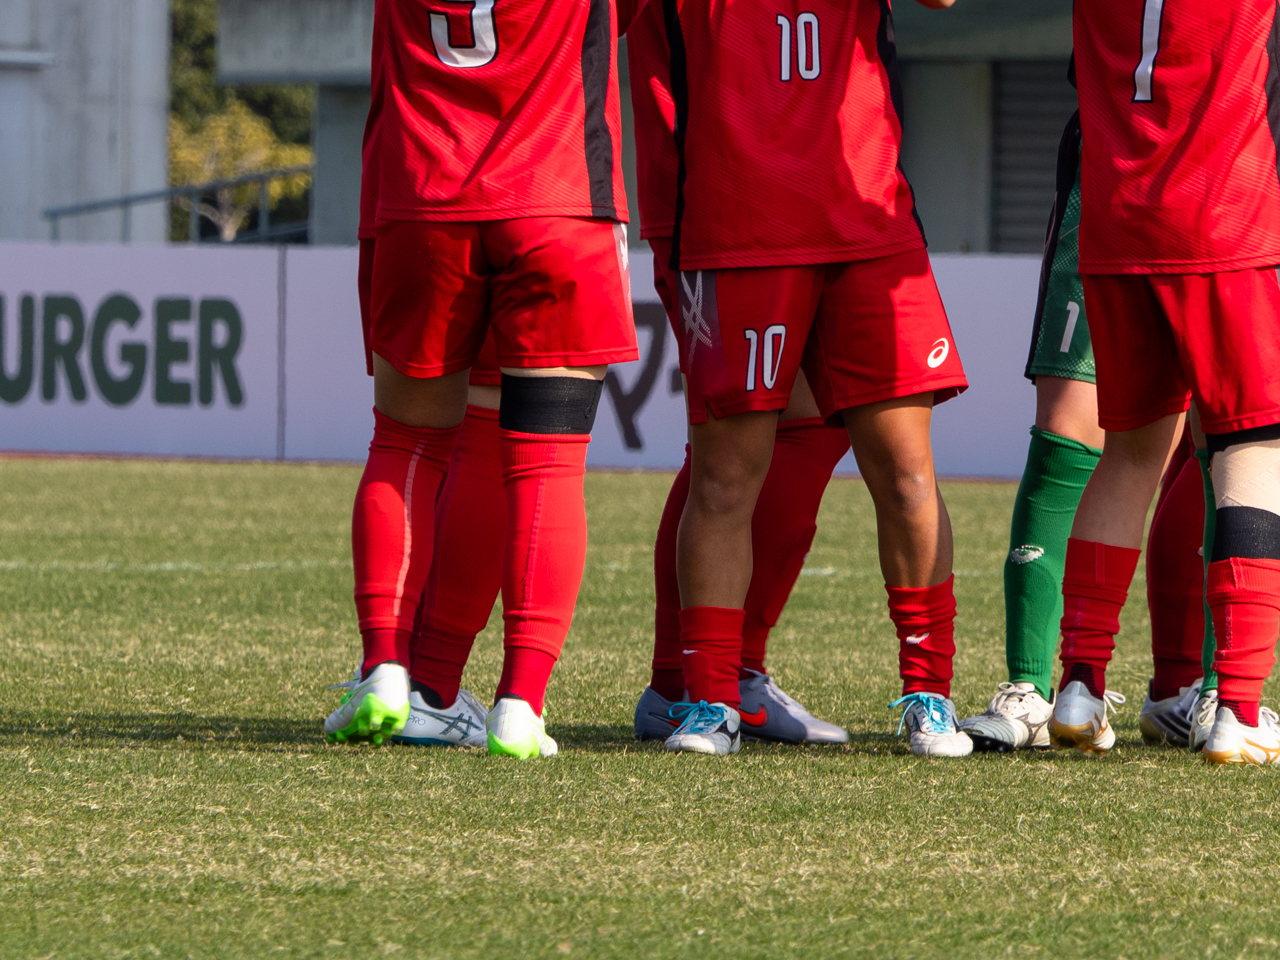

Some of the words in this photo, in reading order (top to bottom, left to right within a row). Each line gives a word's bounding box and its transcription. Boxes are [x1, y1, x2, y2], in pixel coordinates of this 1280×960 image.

[776, 11, 821, 82] 10
[0, 293, 246, 407] URGER
[744, 323, 786, 392] 10
[1060, 301, 1080, 353] 1
